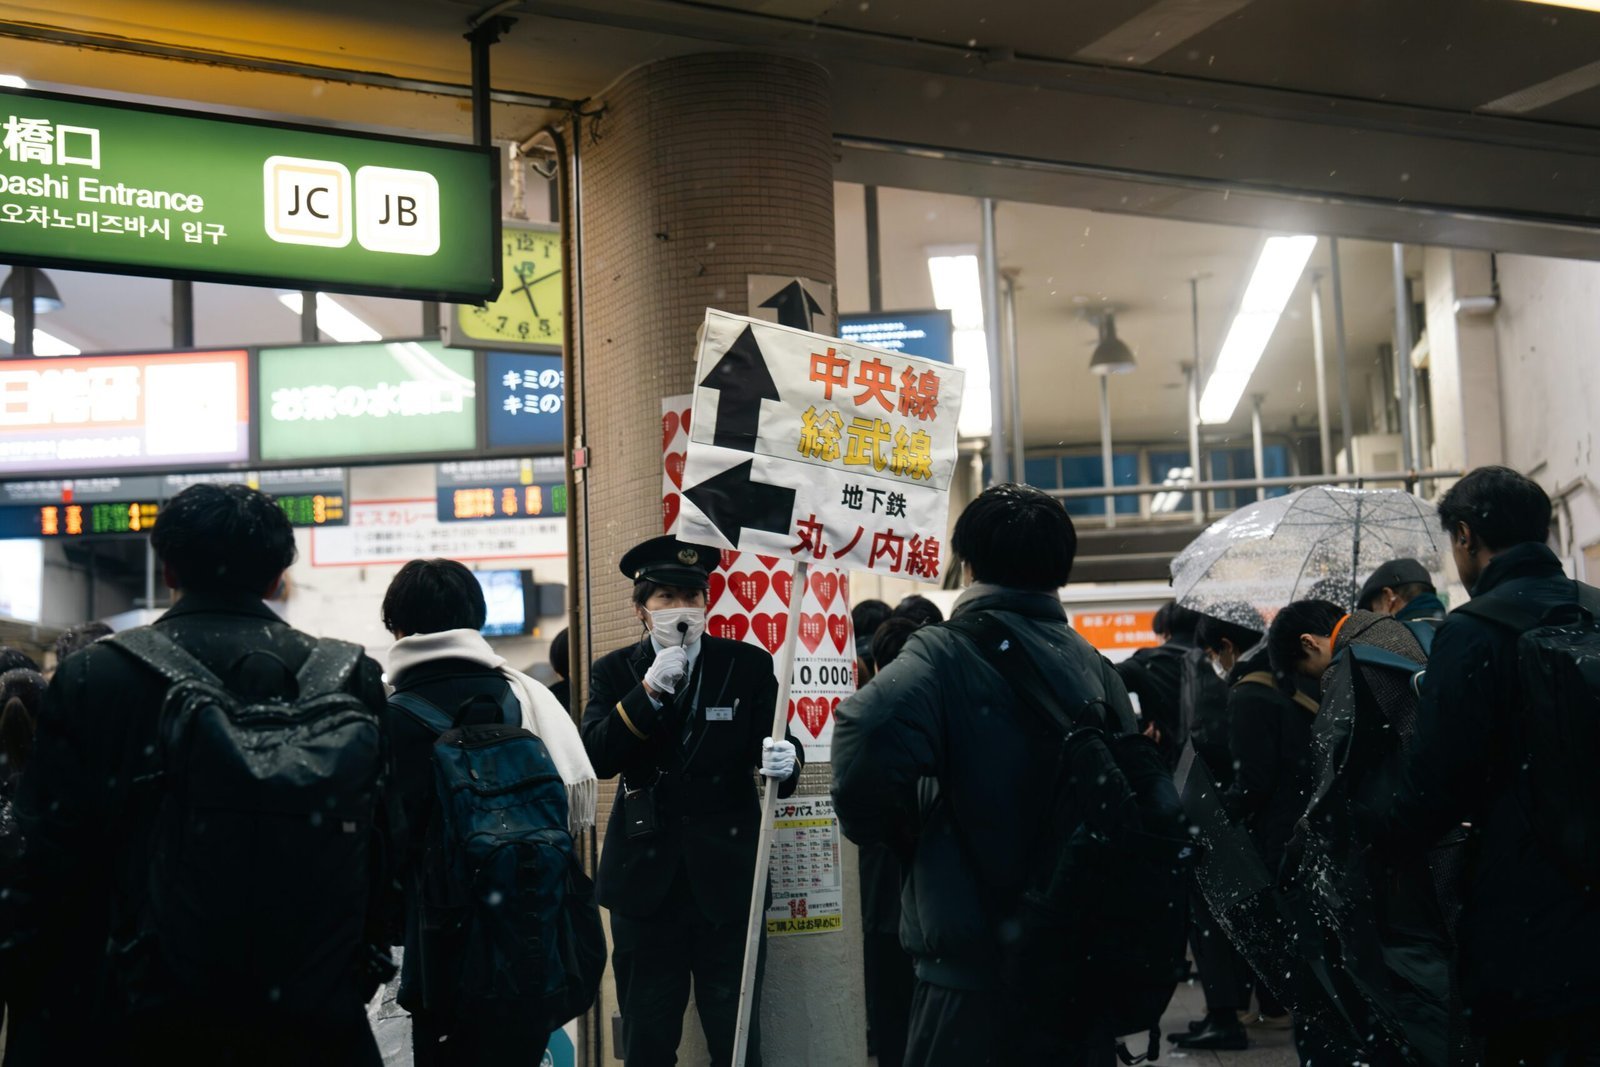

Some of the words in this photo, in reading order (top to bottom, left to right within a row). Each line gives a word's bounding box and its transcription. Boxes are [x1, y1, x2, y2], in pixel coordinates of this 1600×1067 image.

[0, 116, 100, 169] 橋口
[79, 177, 204, 213] Entrance
[288, 185, 329, 219] JC
[379, 194, 418, 226] JB
[0, 204, 170, 240] 오차노미즈바시
[182, 221, 227, 245] 입구
[516, 238, 534, 252] 12
[809, 347, 940, 422] 中央線
[503, 394, 565, 416] キミの
[797, 405, 933, 480] 総武線
[841, 483, 907, 518] 地下鉄
[790, 514, 941, 579] 丸ノ内線
